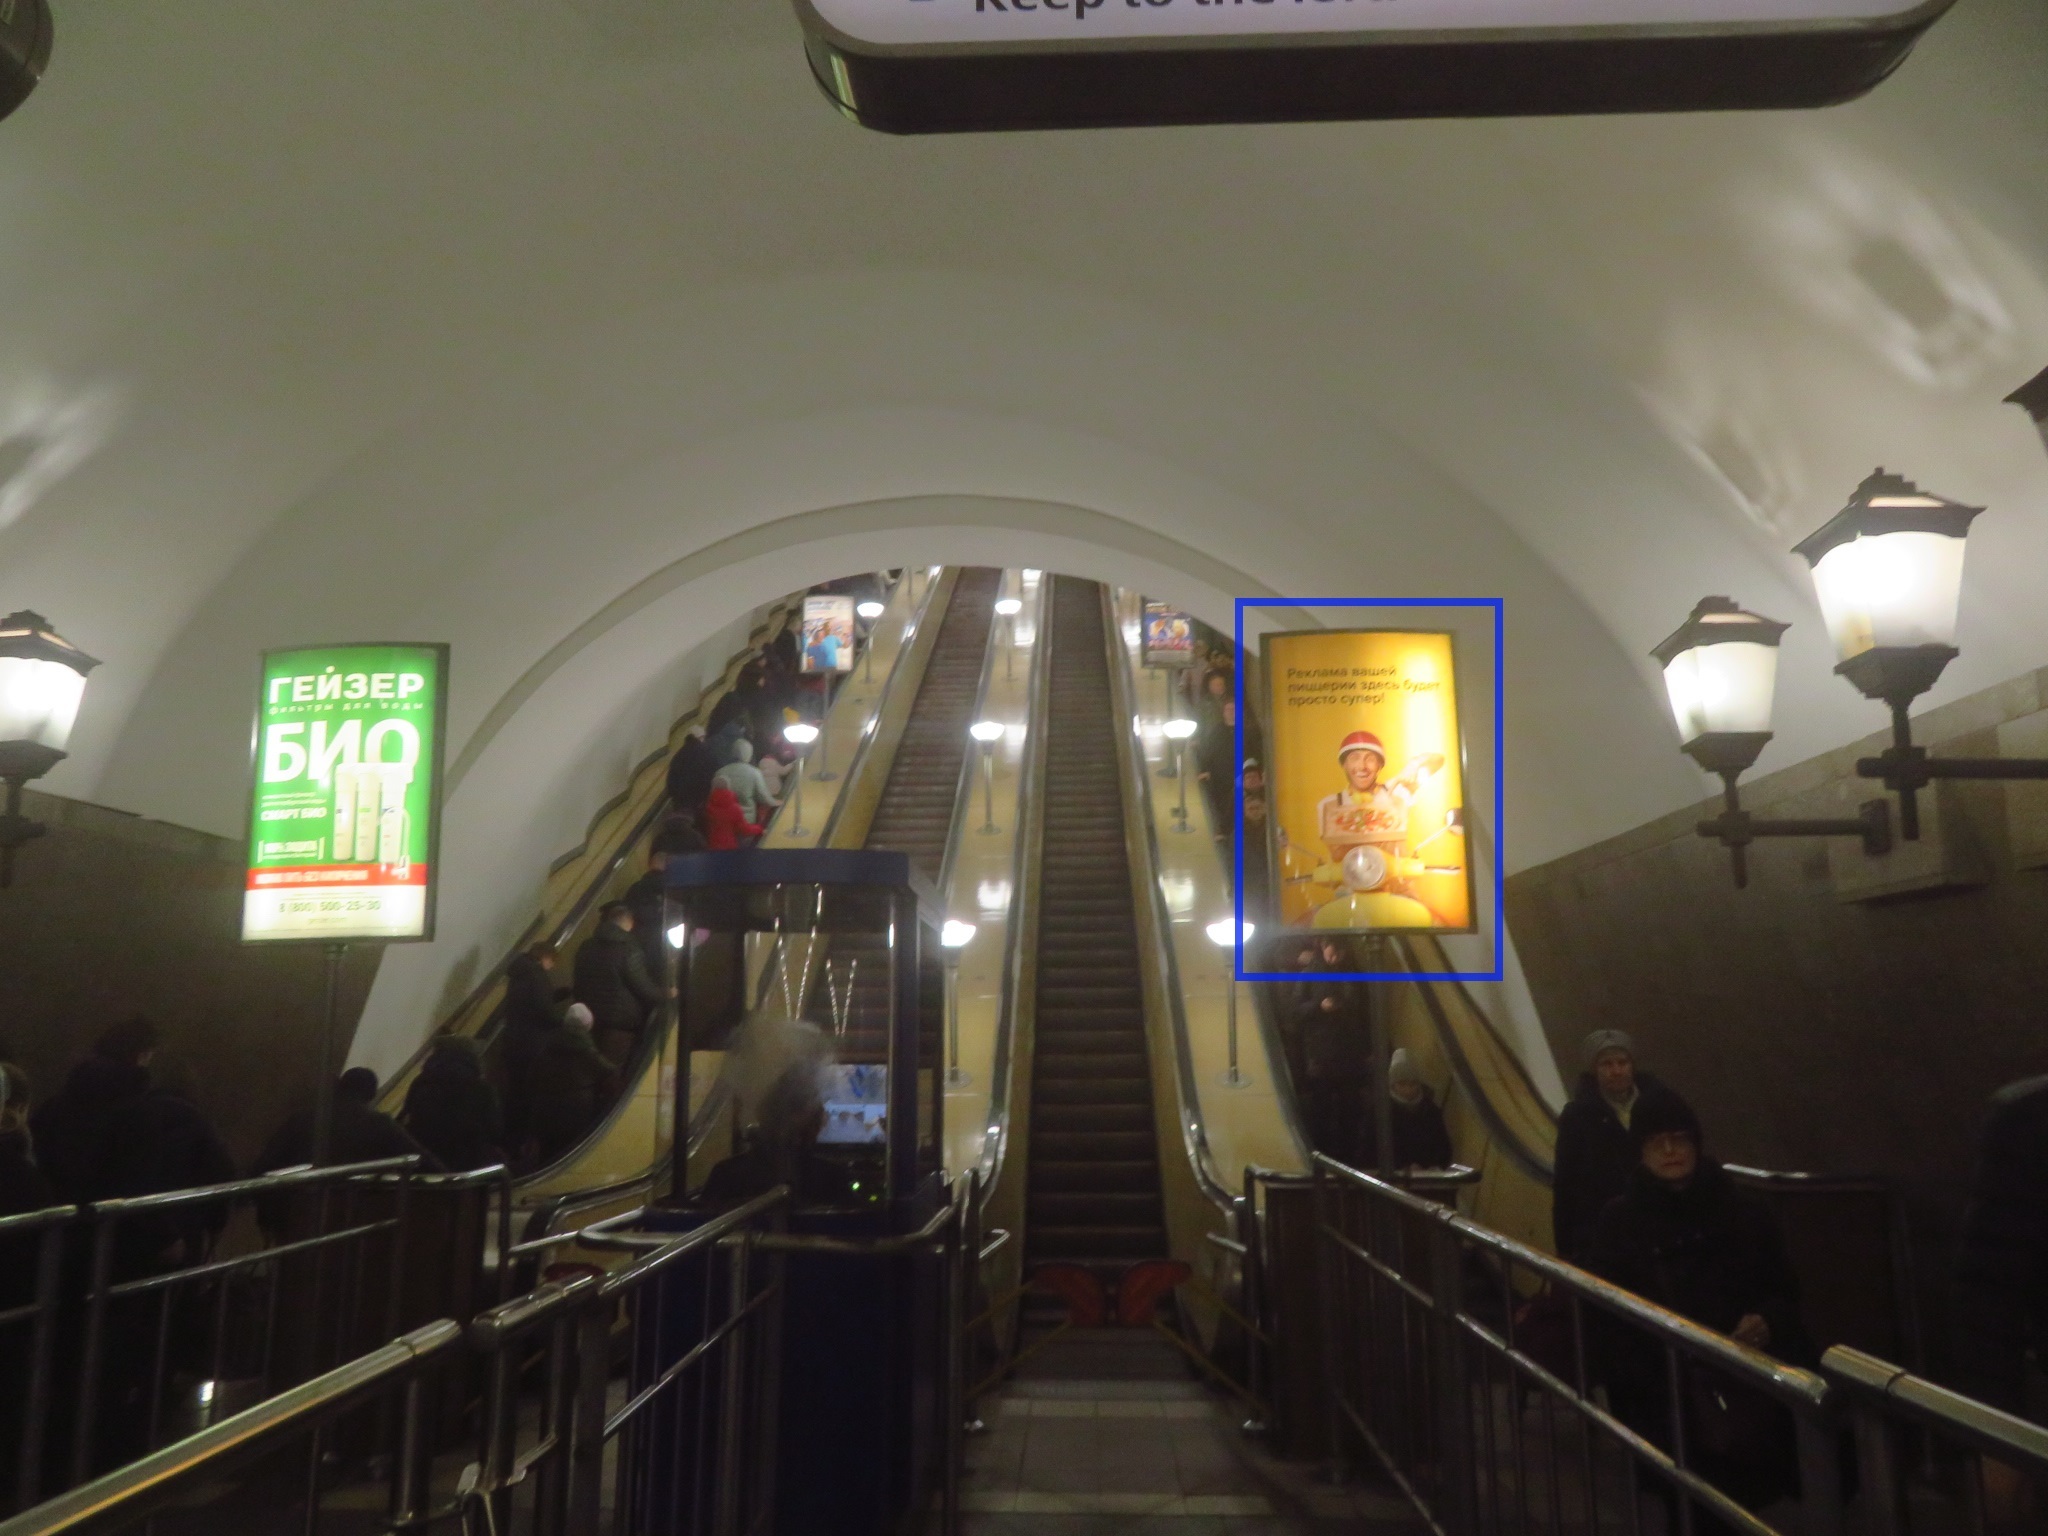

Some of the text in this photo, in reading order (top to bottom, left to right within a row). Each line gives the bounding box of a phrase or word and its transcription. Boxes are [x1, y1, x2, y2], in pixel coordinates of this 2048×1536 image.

[1287, 666, 1397, 679] Реклама вашей
[269, 665, 425, 704] ГЕЙЗЕР
[1287, 678, 1441, 693] пиццерии здесь будет
[1288, 692, 1385, 707] просто супер!
[262, 718, 421, 783] БИО
